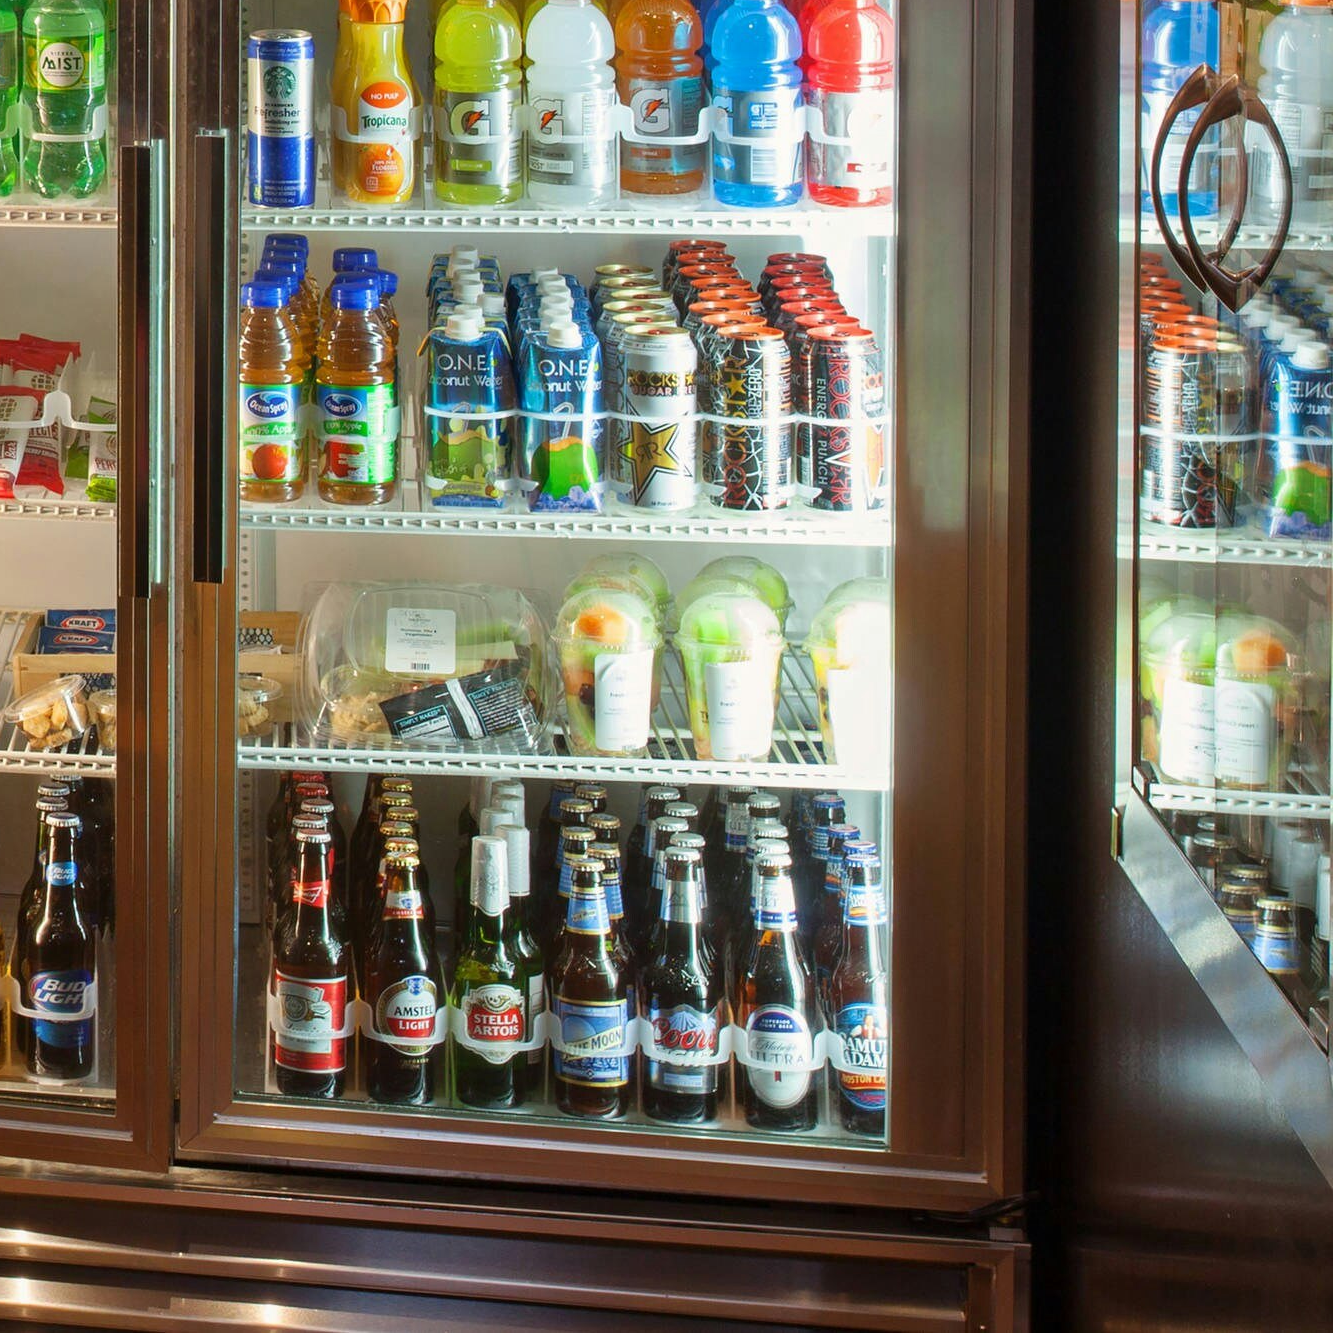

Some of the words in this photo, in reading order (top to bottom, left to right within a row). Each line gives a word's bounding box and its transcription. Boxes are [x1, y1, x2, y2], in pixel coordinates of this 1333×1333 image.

[42, 56, 81, 71] MIST
[631, 88, 671, 134] G
[361, 114, 408, 129] Tropicana
[451, 99, 492, 145] G
[437, 353, 491, 372] O.N.E.
[249, 400, 270, 414] Ocean
[270, 401, 288, 415] Spray
[68, 619, 98, 628] KRAFT
[41, 978, 87, 993] BUD
[393, 1004, 434, 1017] AMSTEL
[398, 1018, 431, 1031] LIGHT
[473, 1014, 519, 1025] STELLA
[473, 1025, 520, 1036] ARTOIS
[652, 1017, 718, 1050] Coors
[591, 1030, 622, 1051] MOON
[840, 1032, 886, 1054] SAMU
[841, 1051, 886, 1067] ADAM
